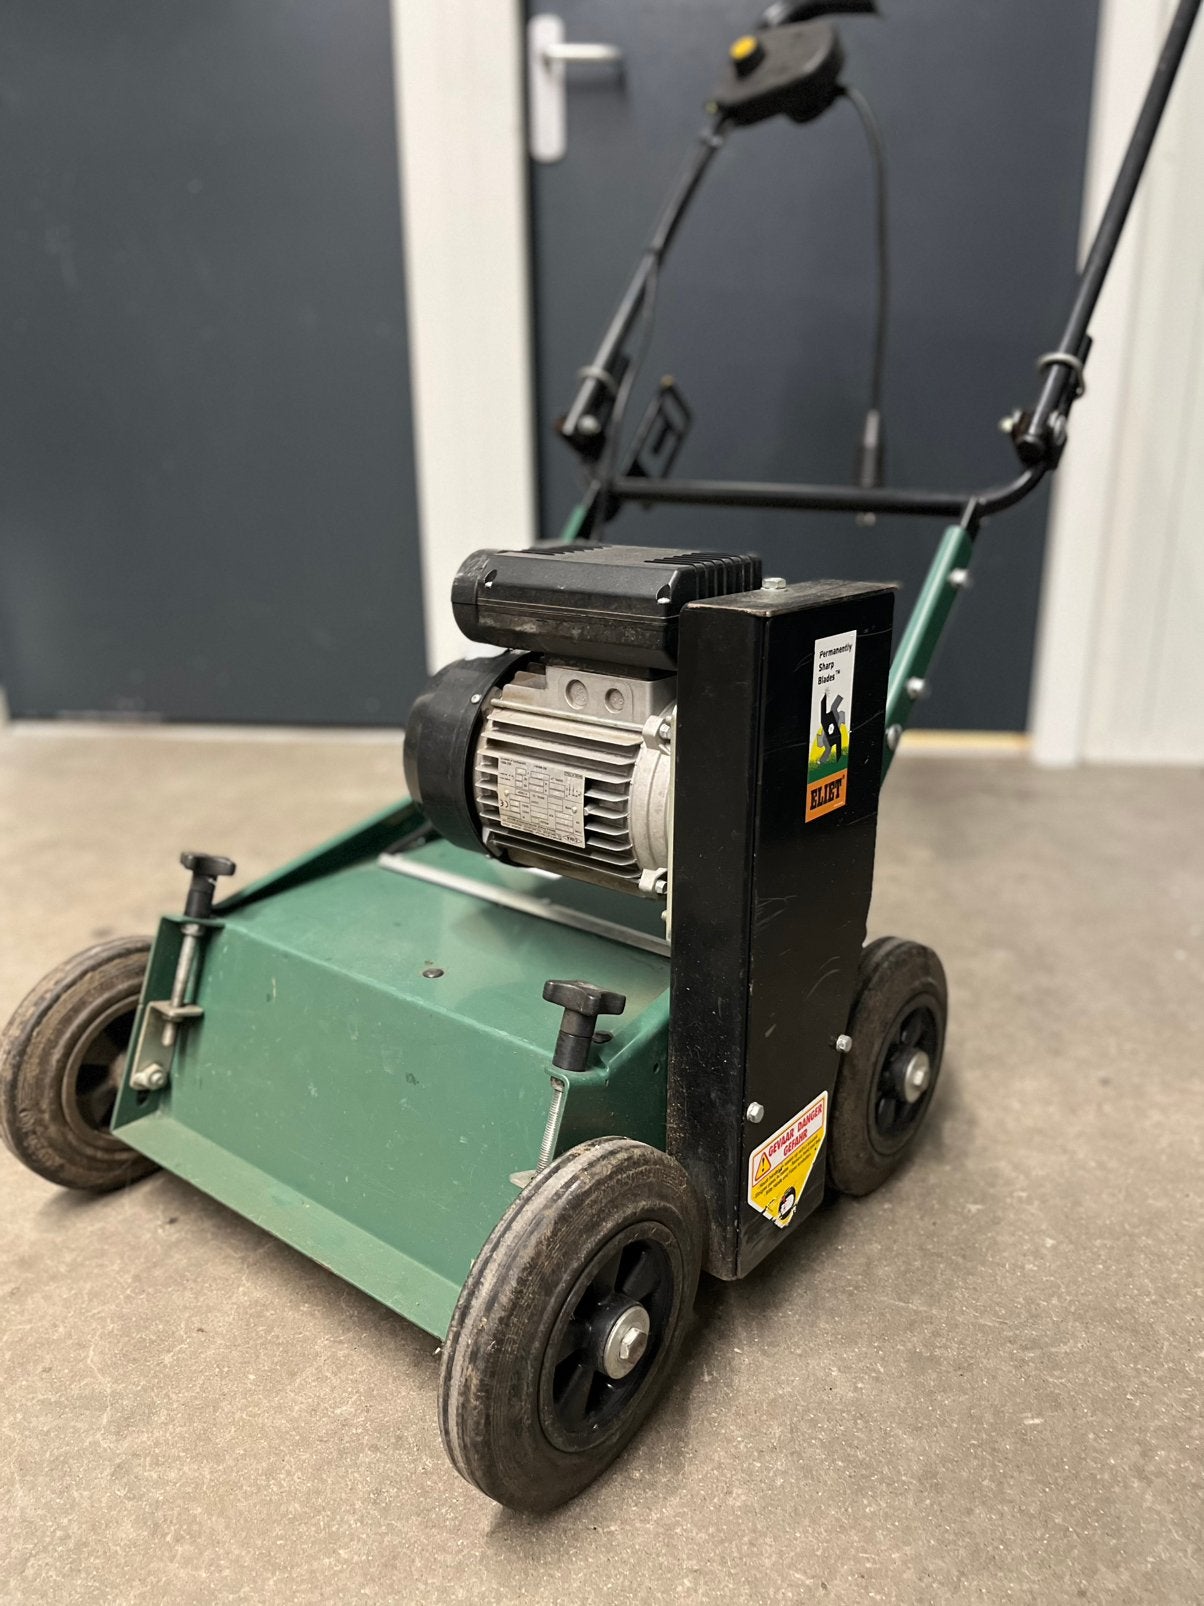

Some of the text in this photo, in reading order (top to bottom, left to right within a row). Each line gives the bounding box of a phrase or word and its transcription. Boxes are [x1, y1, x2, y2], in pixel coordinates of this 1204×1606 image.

[819, 643, 852, 658] Permanently
[818, 661, 835, 671] Sharp
[810, 778, 842, 810] ELIET
[768, 1104, 823, 1156] GEVAAR DANGER
[783, 1129, 808, 1156] GEFAHR
